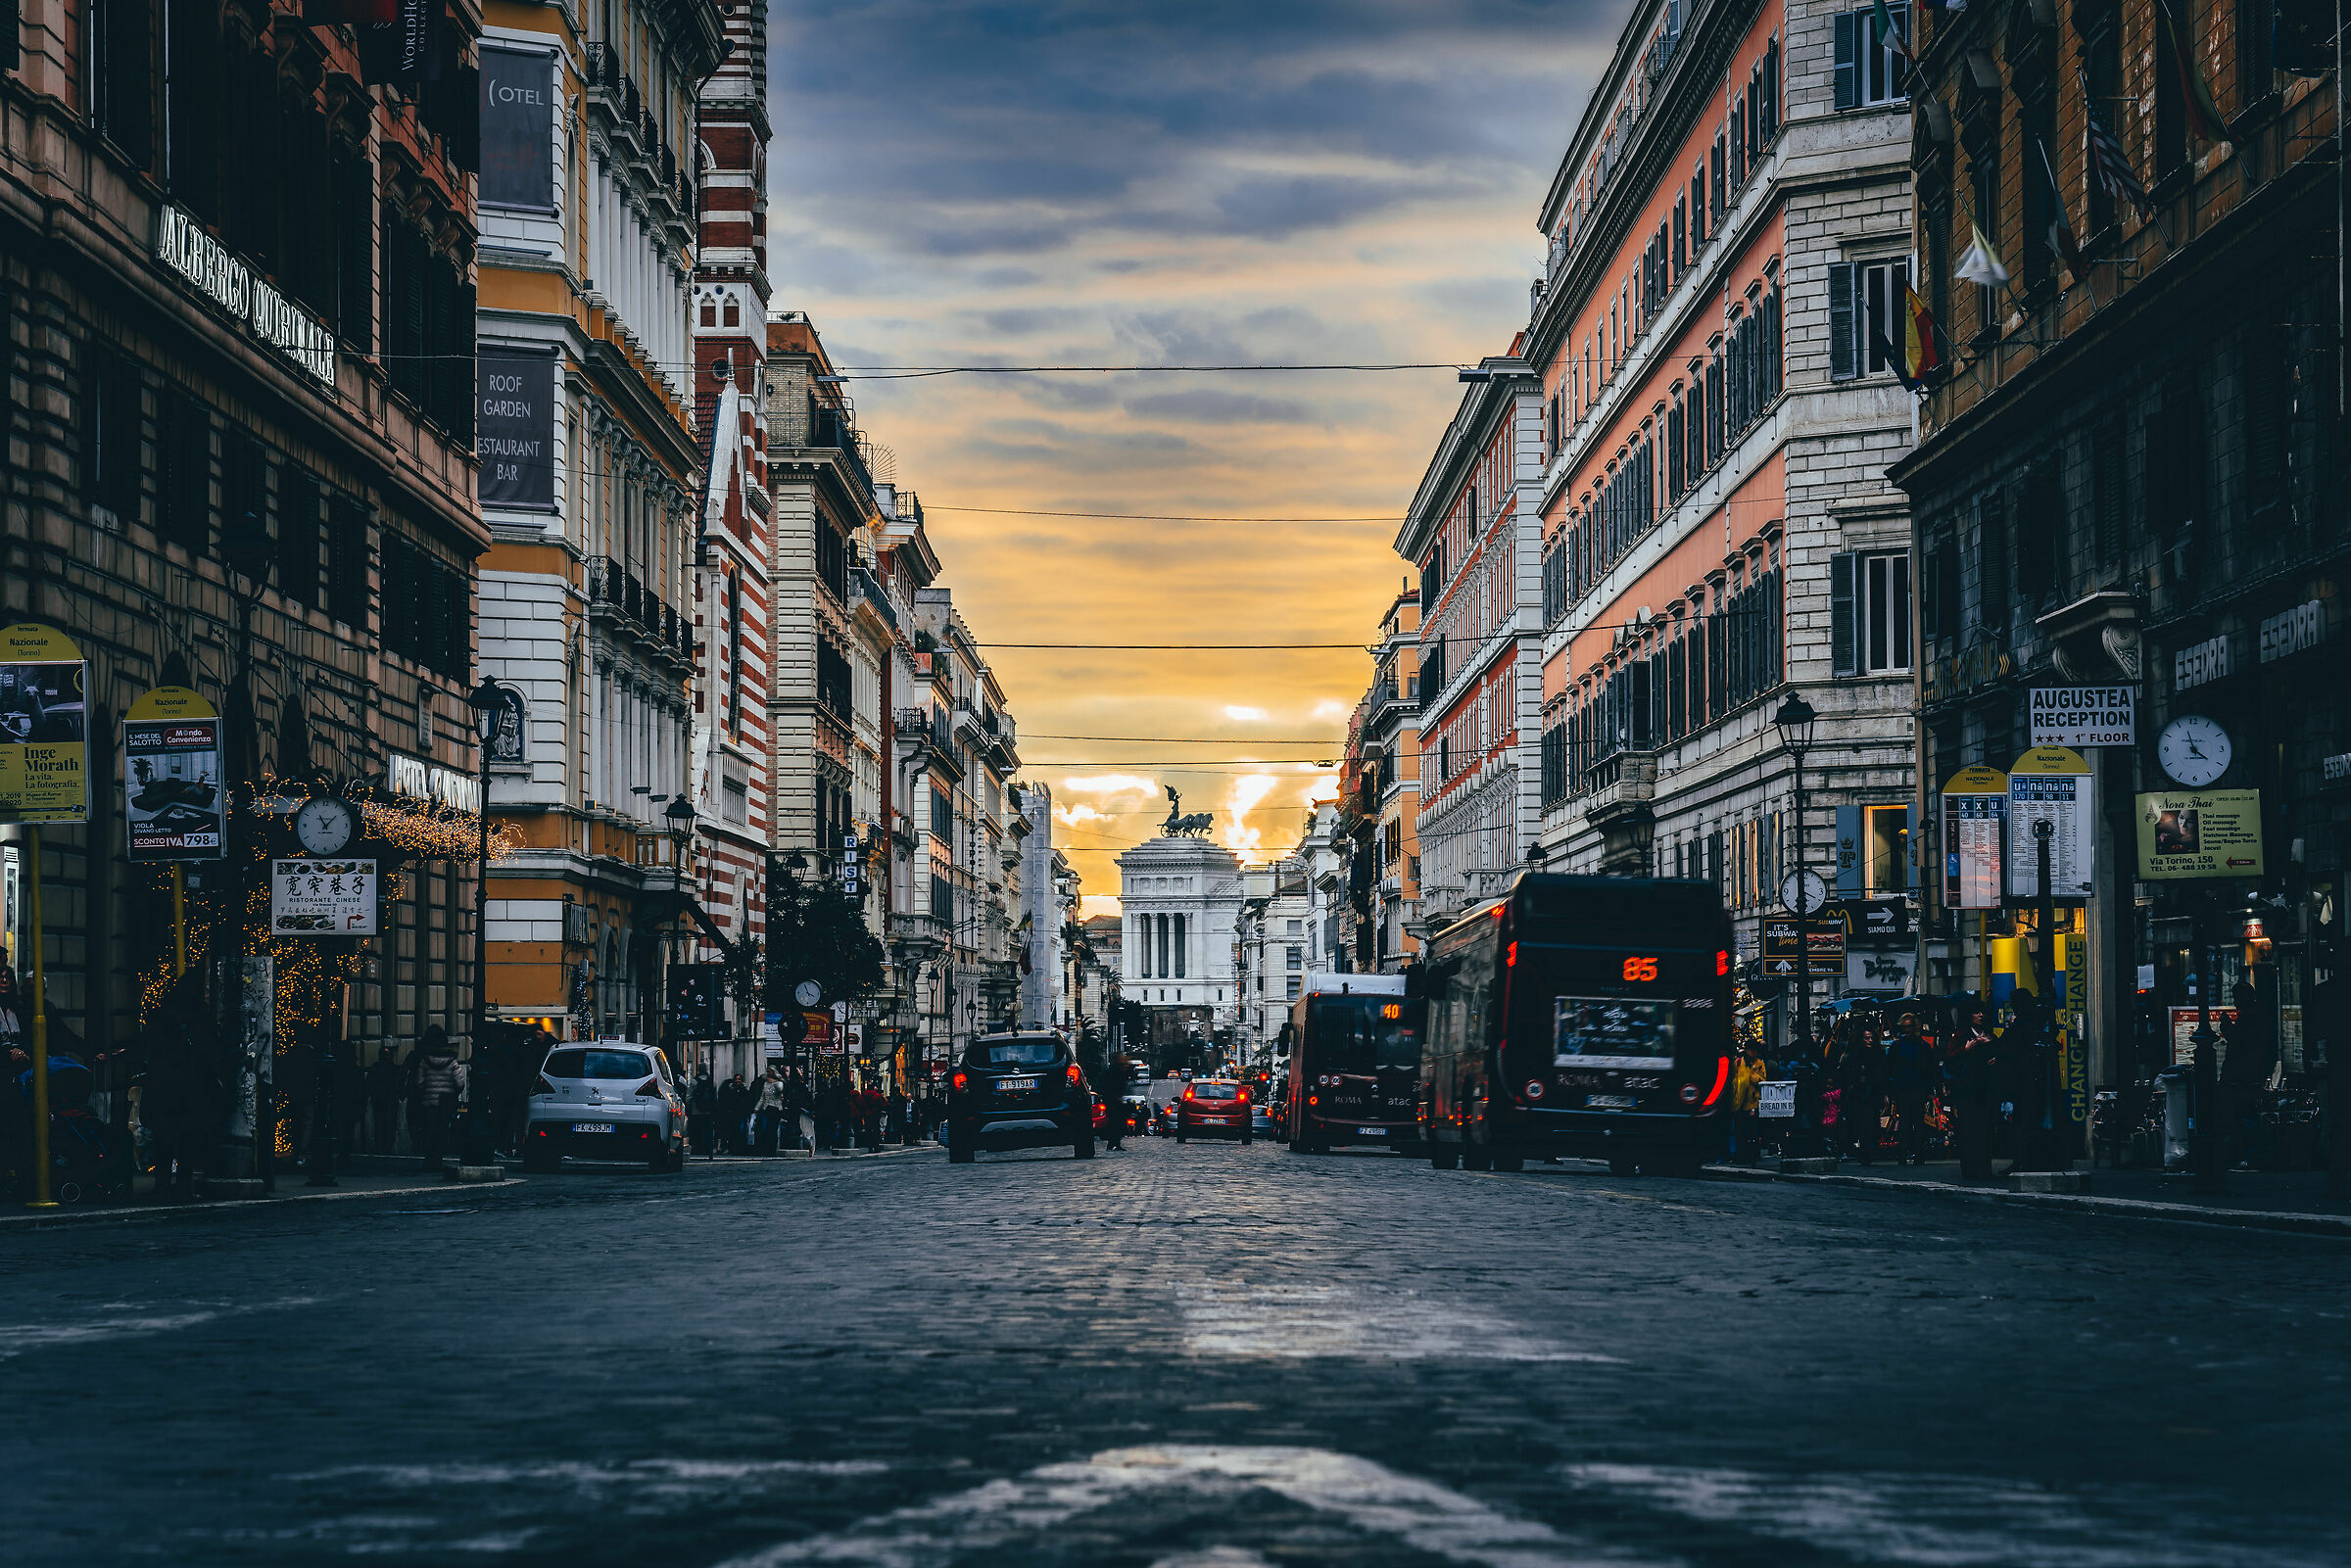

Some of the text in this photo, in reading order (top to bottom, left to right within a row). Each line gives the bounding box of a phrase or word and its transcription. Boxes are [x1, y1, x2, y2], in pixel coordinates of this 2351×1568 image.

[160, 205, 250, 321] ALBERGO
[489, 375, 522, 393] ROOF
[483, 400, 531, 418] GARDEN
[478, 438, 541, 457] ESTAURANT
[497, 463, 518, 481] BAR
[2259, 600, 2318, 664] ESEDRA
[9, 638, 48, 647] Nazionale
[2174, 635, 2229, 691] ESEDRA
[2033, 689, 2132, 709] AUGUSTEA
[2033, 711, 2131, 728] RECEPTION
[167, 736, 212, 744] Convenienza
[2089, 733, 2130, 742] FLOOR
[24, 747, 56, 762] Inge
[24, 758, 79, 773] Morath
[36, 773, 55, 782] vita.
[37, 780, 80, 790] fotografia.
[2158, 796, 2185, 809] Nora
[2187, 795, 2215, 808] Thai
[133, 837, 166, 846] SCONTO
[167, 836, 183, 847] IVA
[2166, 856, 2195, 866] Torino,
[1623, 956, 1658, 981] 85
[1383, 1003, 1401, 1020] 40
[1333, 1096, 1363, 1105] ROMA
[1387, 1097, 1412, 1107] atac
